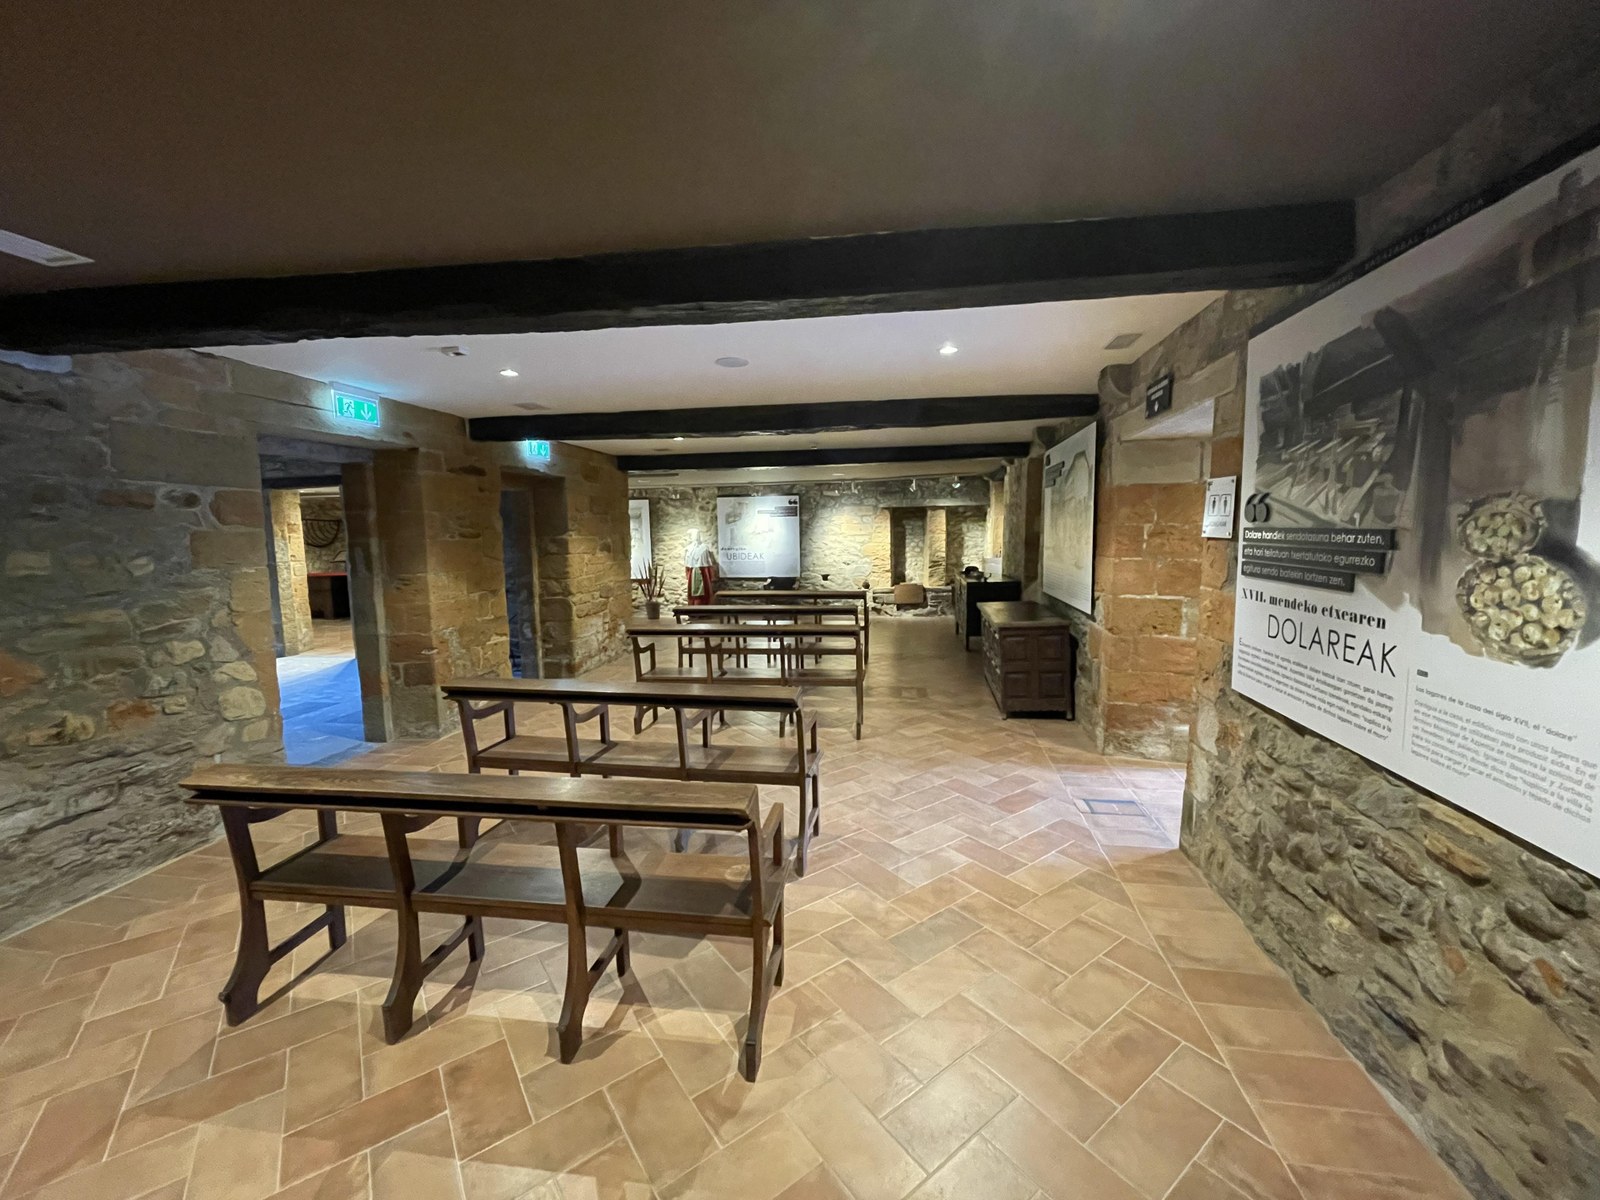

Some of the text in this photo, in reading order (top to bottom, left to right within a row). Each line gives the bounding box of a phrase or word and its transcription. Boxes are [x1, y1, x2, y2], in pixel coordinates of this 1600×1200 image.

[1245, 530, 1261, 539] Dolare
[1331, 533, 1356, 544] behar
[726, 552, 765, 561] UBIDEAK
[1244, 547, 1253, 556] eta
[1334, 554, 1376, 567] egurrezko
[1261, 566, 1279, 576] sendo
[1304, 570, 1328, 582] lortzen
[1241, 587, 1387, 630] XVII. mendeko etxearen
[1267, 614, 1398, 678] DOLAREAK
[1465, 702, 1481, 711] casa
[1482, 707, 1493, 715] del
[1495, 711, 1511, 722] siglo
[1532, 722, 1540, 730] el
